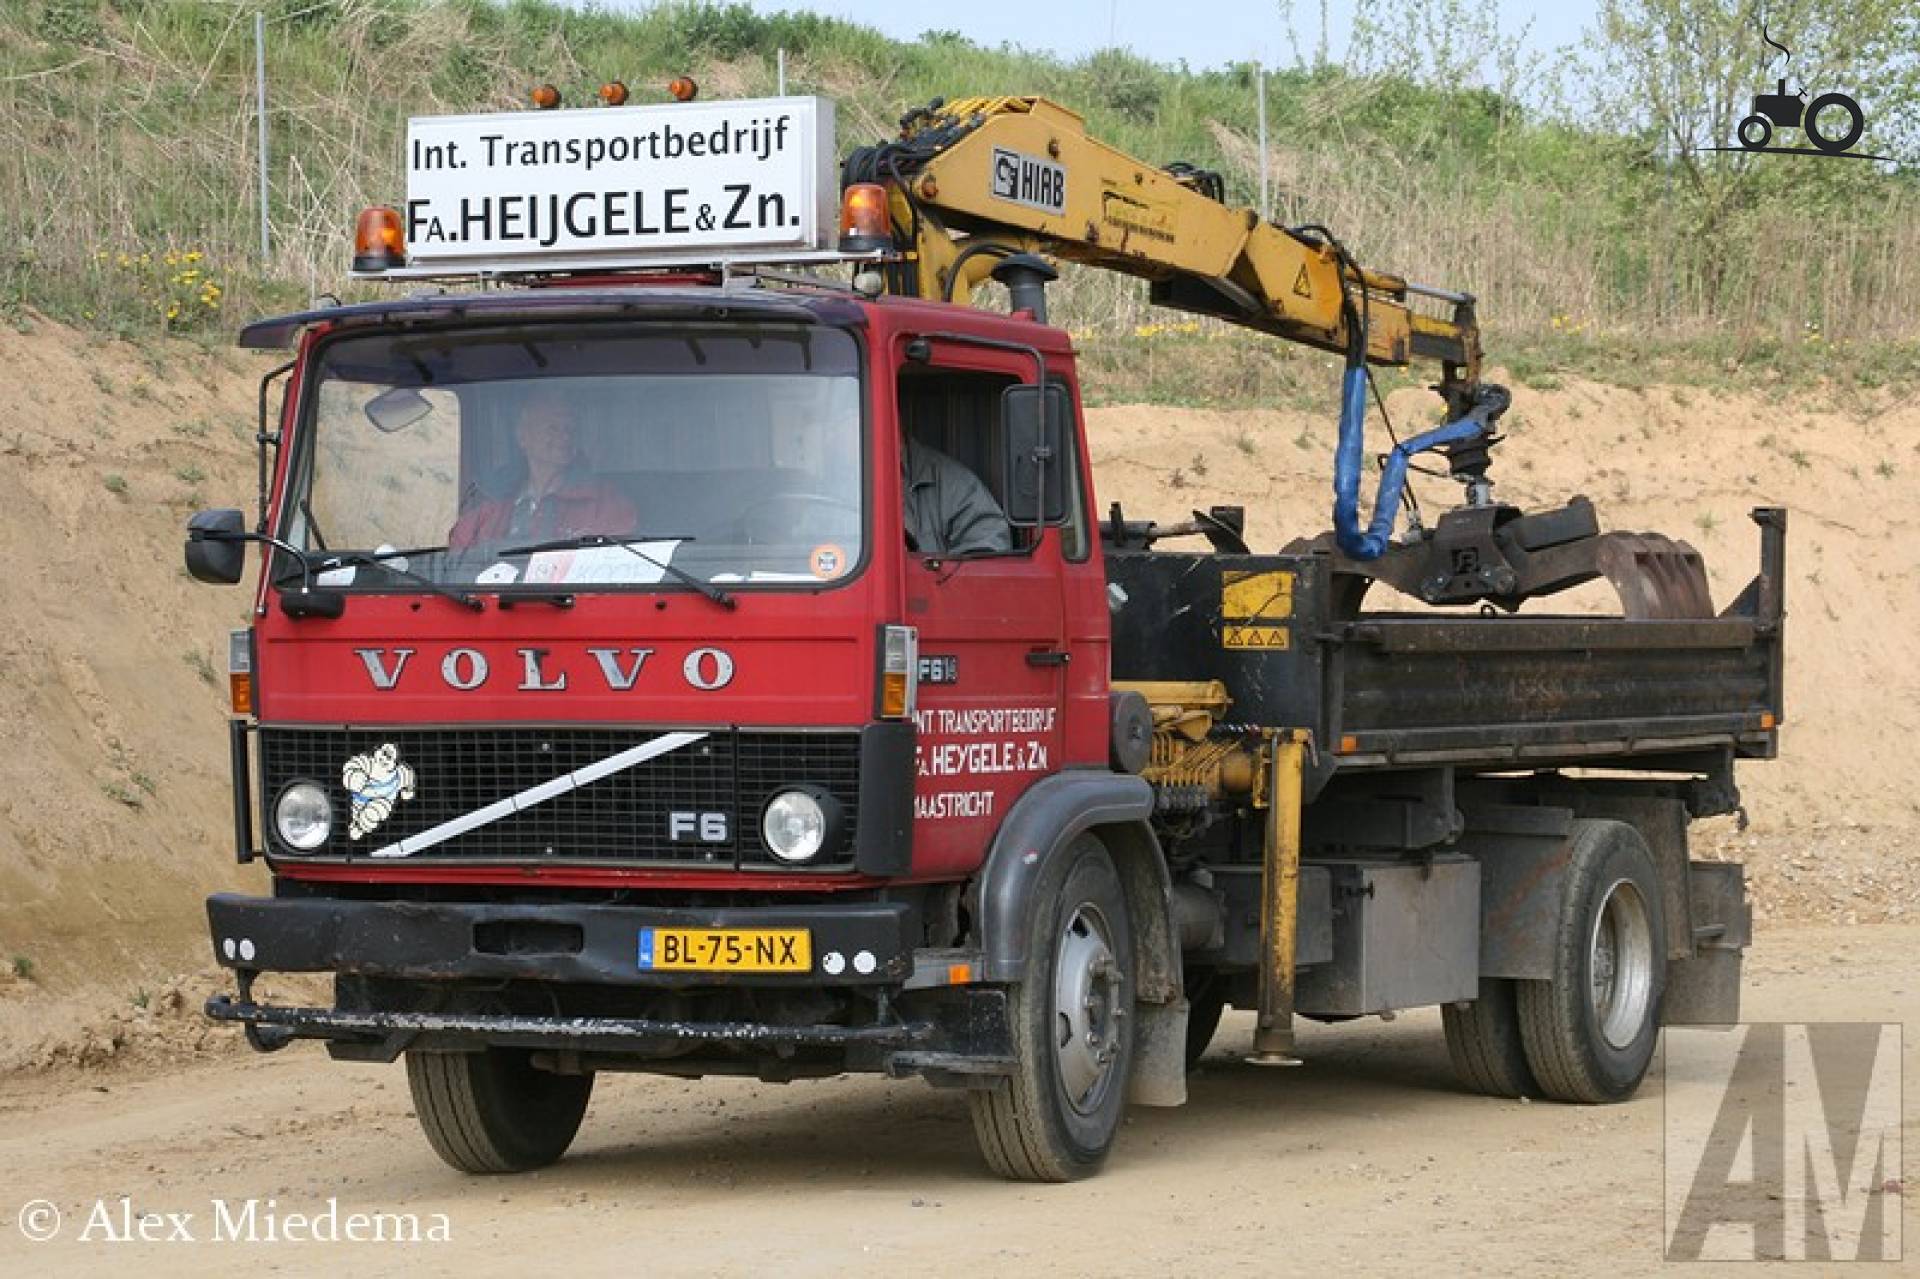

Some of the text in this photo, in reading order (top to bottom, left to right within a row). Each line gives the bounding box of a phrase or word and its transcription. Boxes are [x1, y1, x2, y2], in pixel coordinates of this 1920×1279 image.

[413, 114, 791, 171] Int. Transportbedrijf
[1022, 160, 1063, 207] HIAB
[695, 203, 716, 231] &
[722, 183, 800, 229] Zn.
[354, 647, 736, 692] VOLVO
[669, 812, 727, 841] F6
[663, 935, 796, 964] BL-75-NX
